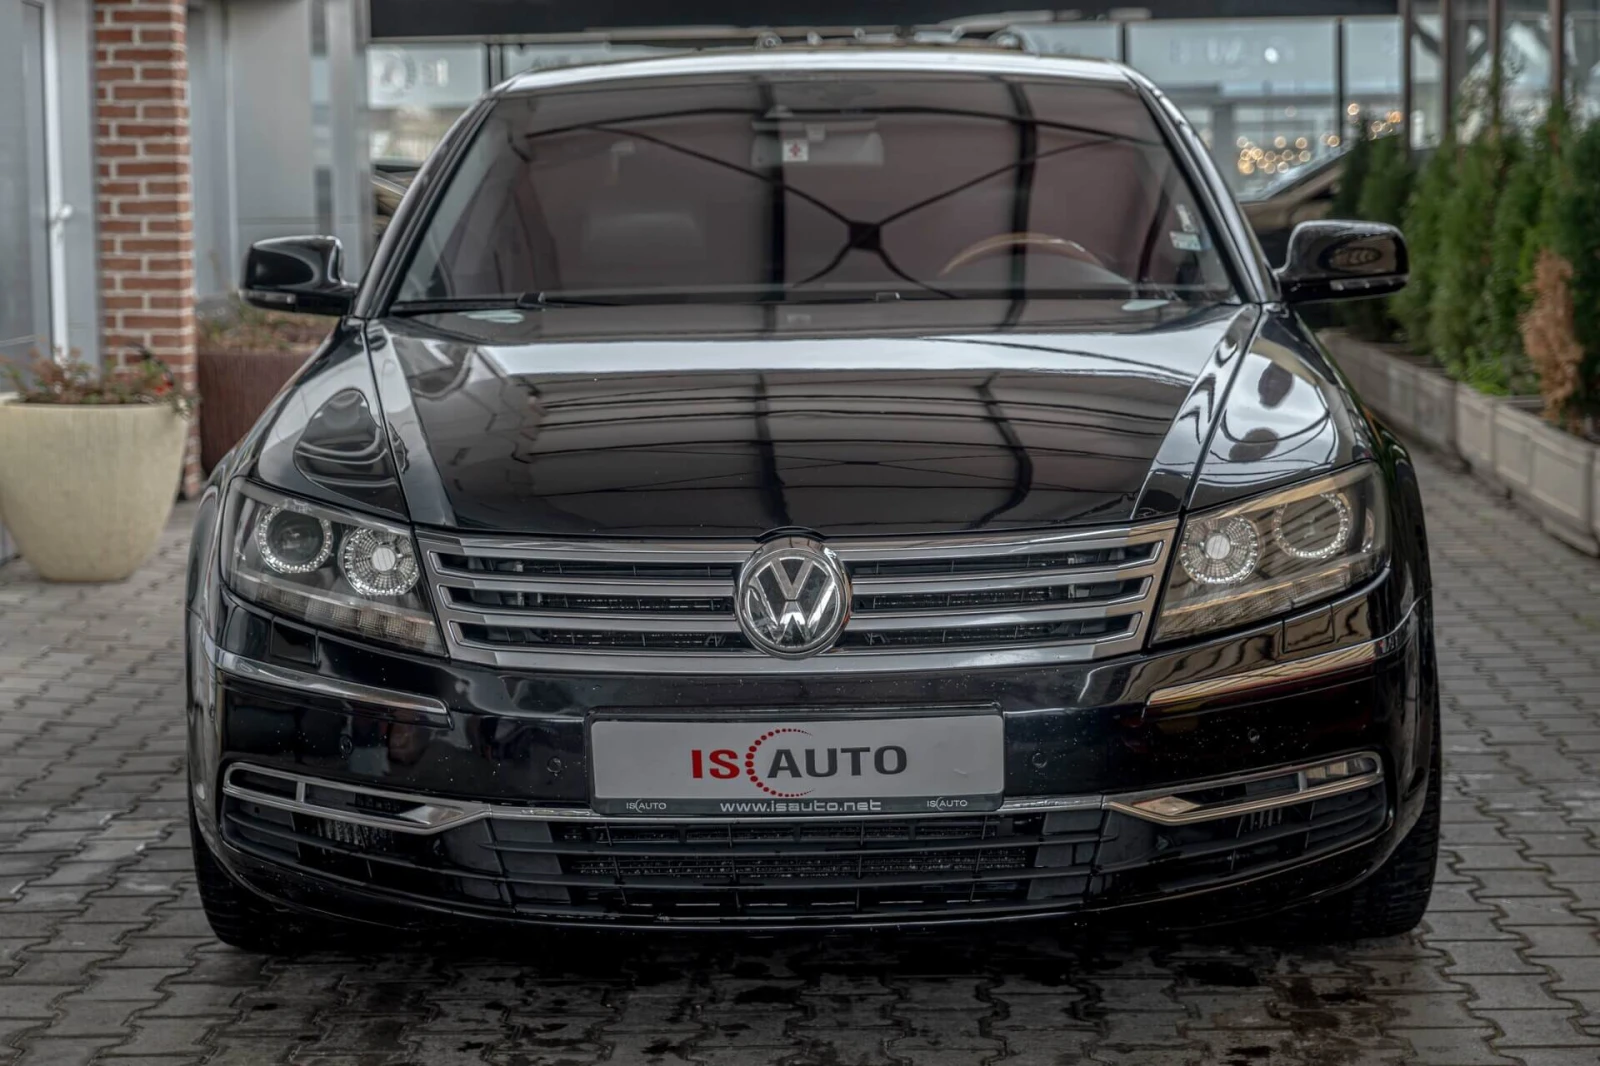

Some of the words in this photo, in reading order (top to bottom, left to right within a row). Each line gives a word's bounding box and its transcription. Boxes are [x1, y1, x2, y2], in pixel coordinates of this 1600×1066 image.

[749, 556, 837, 645] VW
[691, 749, 740, 779] IS
[767, 745, 908, 779] AUTO
[720, 799, 882, 812] www.isauto.net
